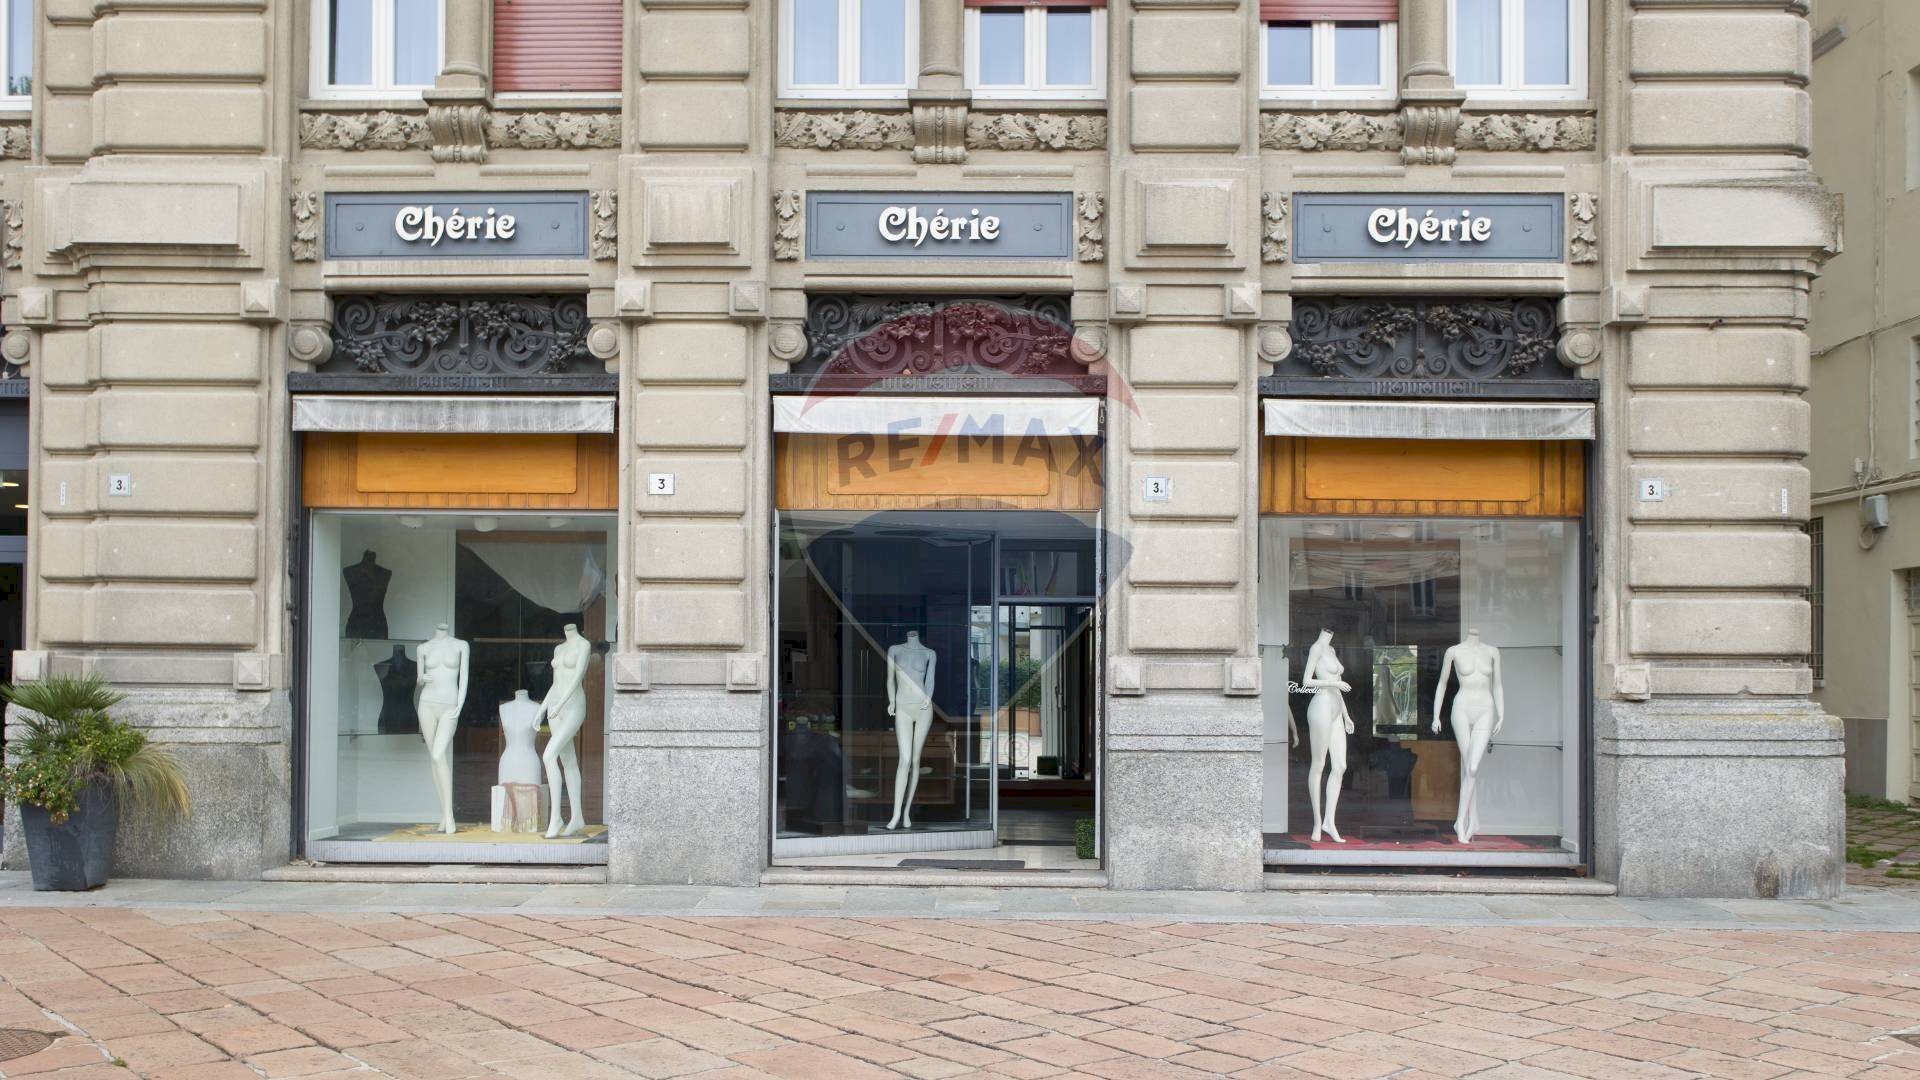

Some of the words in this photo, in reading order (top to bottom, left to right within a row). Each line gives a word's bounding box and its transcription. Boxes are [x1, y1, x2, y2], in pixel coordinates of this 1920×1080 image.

[395, 205, 516, 247] Chérie
[879, 206, 1000, 248] Chérie
[1368, 207, 1492, 249] Chérie
[657, 478, 666, 490] 3
